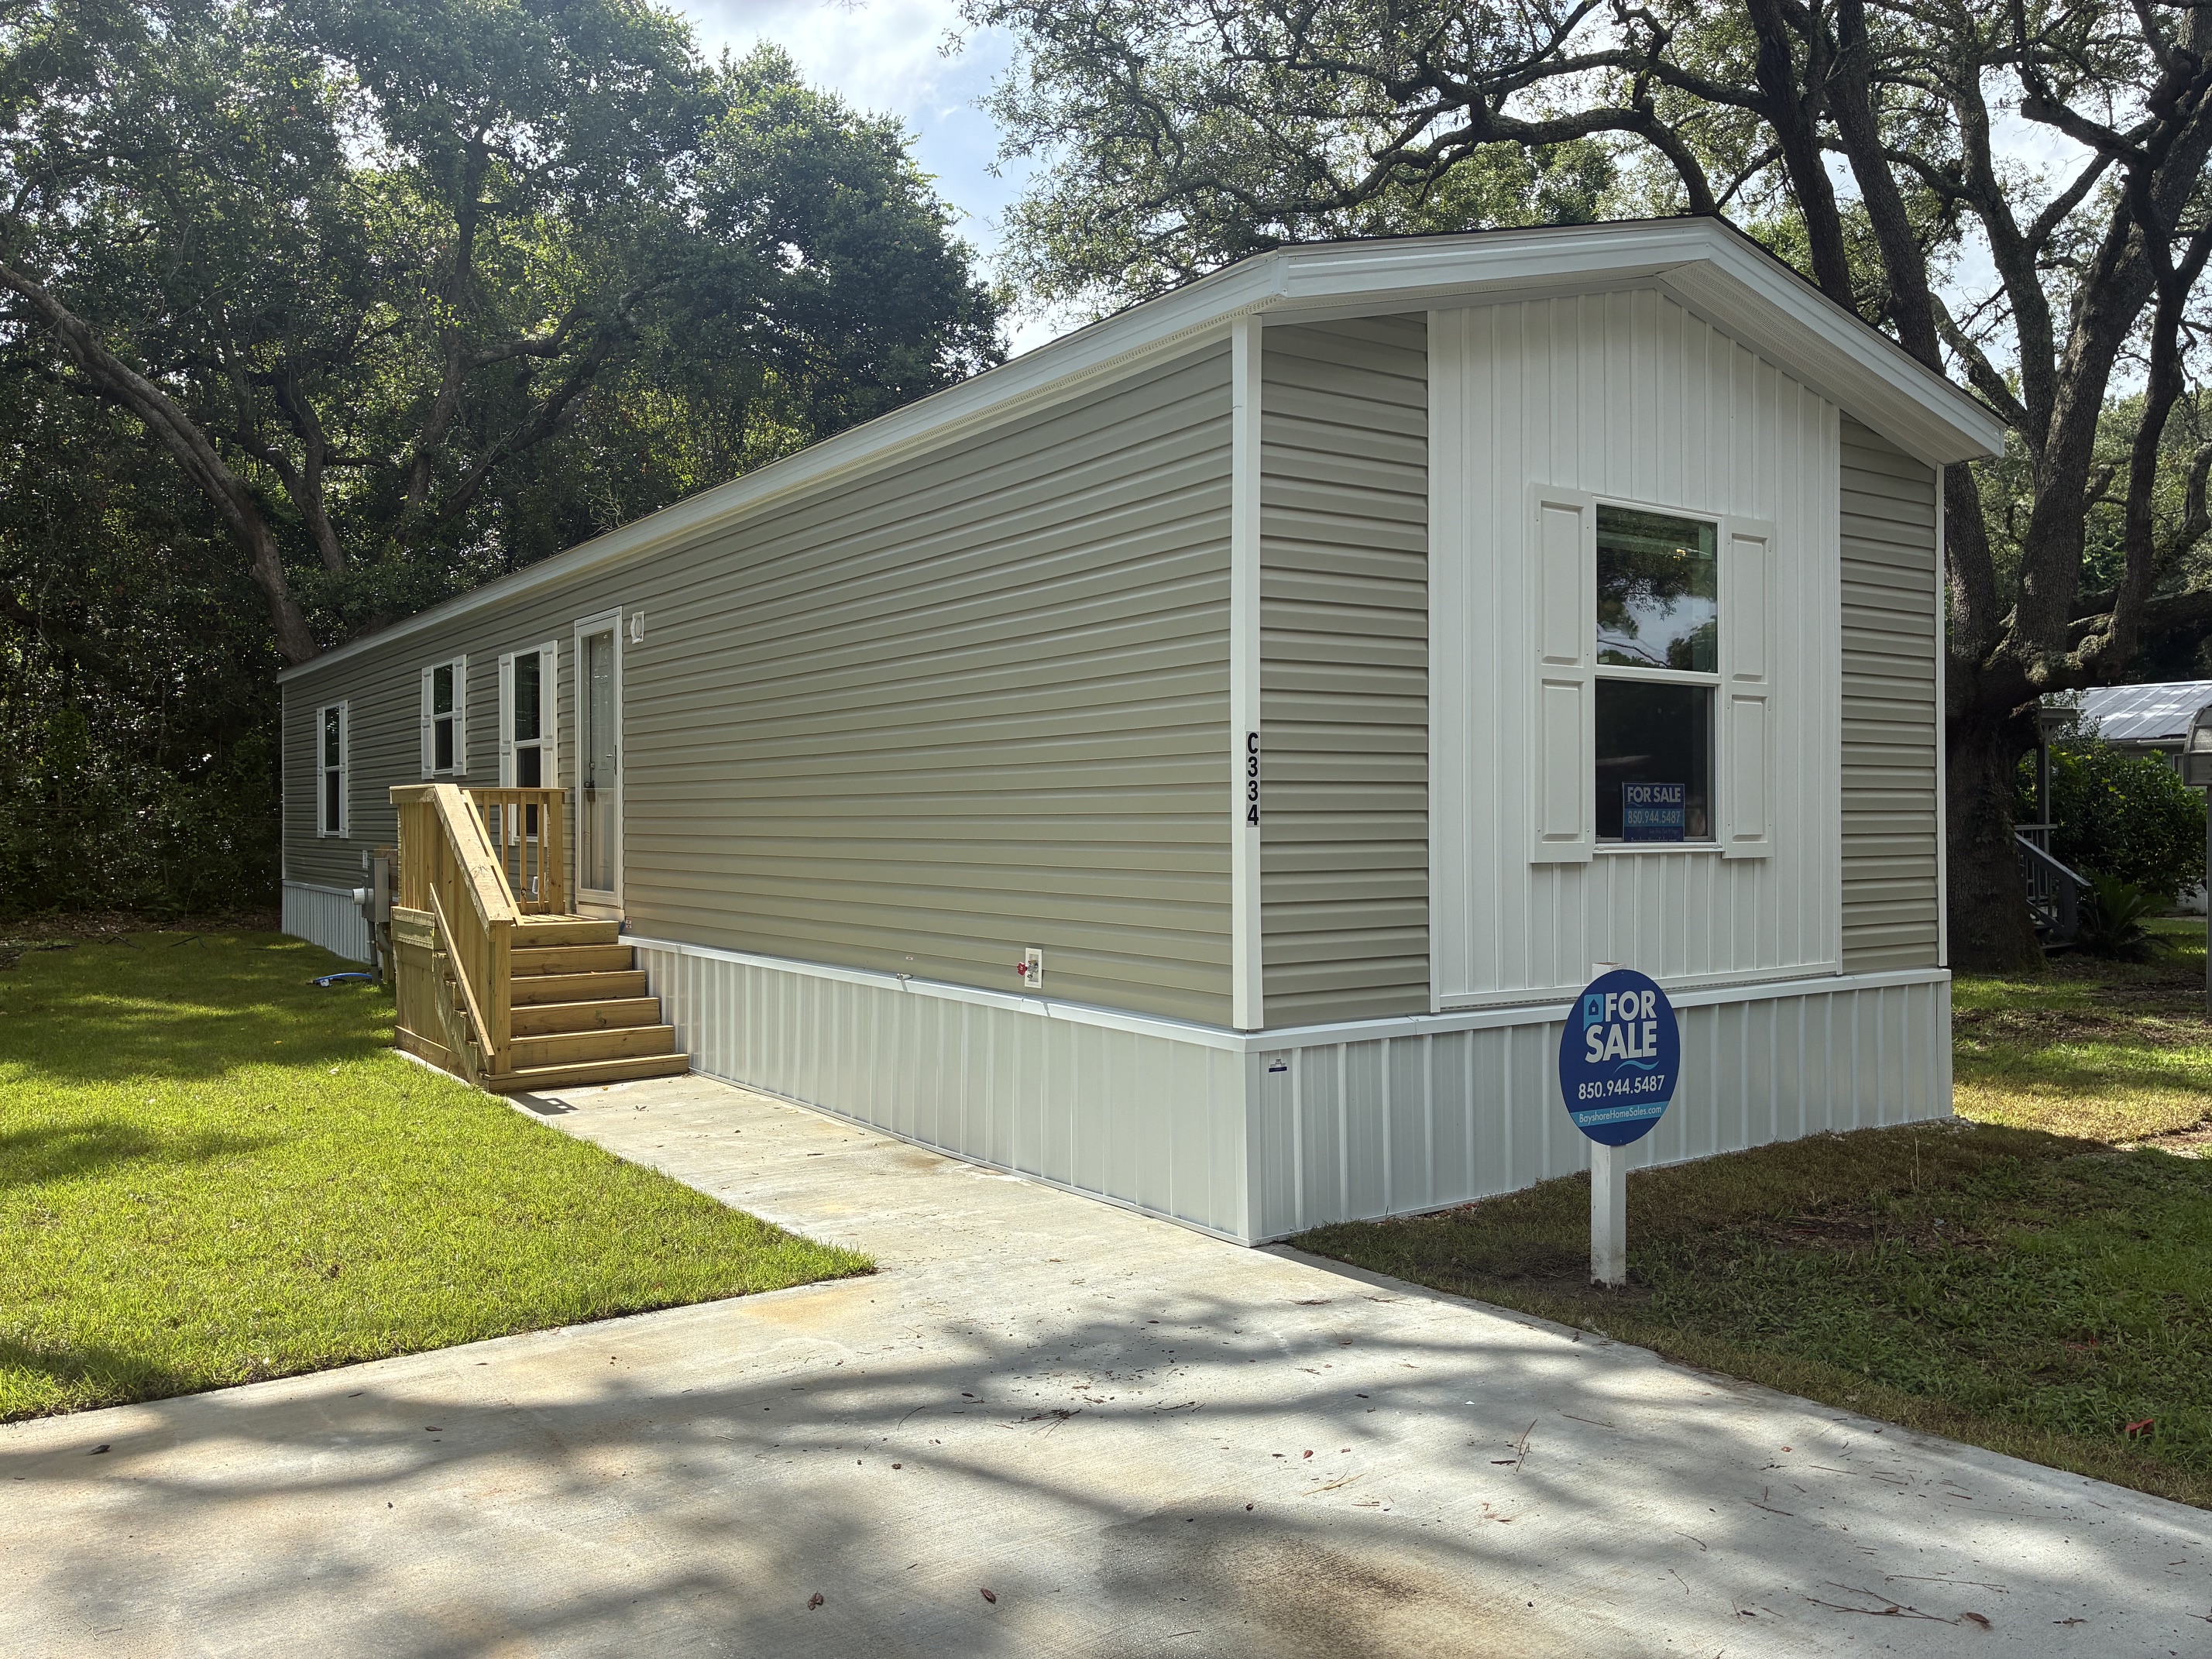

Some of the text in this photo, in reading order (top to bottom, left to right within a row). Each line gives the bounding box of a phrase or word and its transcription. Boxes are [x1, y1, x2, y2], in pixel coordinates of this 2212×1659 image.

[1247, 732, 1259, 826] C334
[1627, 786, 1681, 802] FOR SALE
[1627, 810, 1681, 824] 850.944.5487
[1605, 990, 1657, 1022] FOR
[1585, 1020, 1657, 1063] SALE
[1578, 1074, 1665, 1100] 850.944.5487
[1579, 1105, 1662, 1125] BayshoreHomeSales.com
